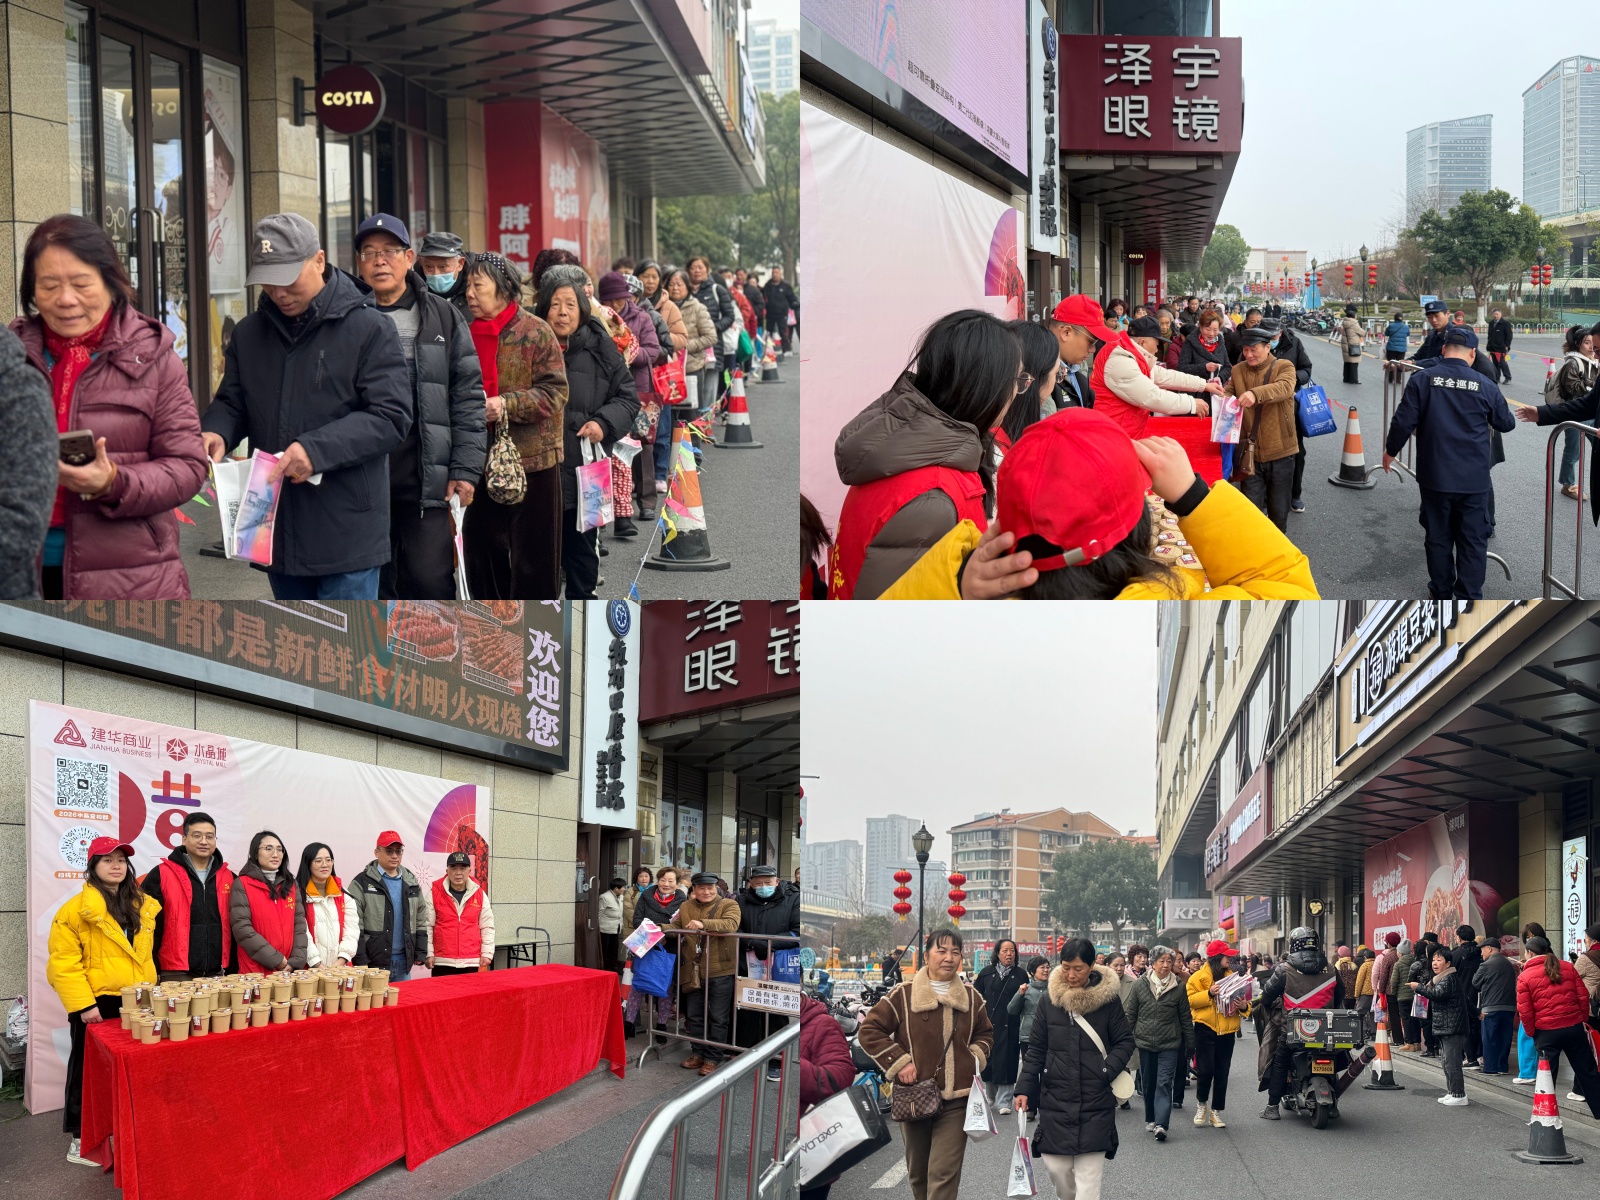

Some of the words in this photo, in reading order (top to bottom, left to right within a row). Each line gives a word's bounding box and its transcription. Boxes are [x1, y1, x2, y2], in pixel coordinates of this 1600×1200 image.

[1104, 43, 1221, 88] 泽宇
[322, 90, 374, 107] COSTA
[1104, 95, 1221, 141] 眼镜
[261, 239, 273, 254] R
[1433, 376, 1480, 391] 安全巡防
[1384, 600, 1436, 679] 游埠豆浆
[526, 627, 561, 747] 欢迎您
[91, 727, 151, 749] 建华商业
[89, 744, 120, 754] JIANHUA
[122, 748, 152, 758] BUSINESS
[194, 743, 227, 761] 水晶城
[193, 757, 214, 767] CRYSTAL
[1173, 907, 1210, 920] KFC
